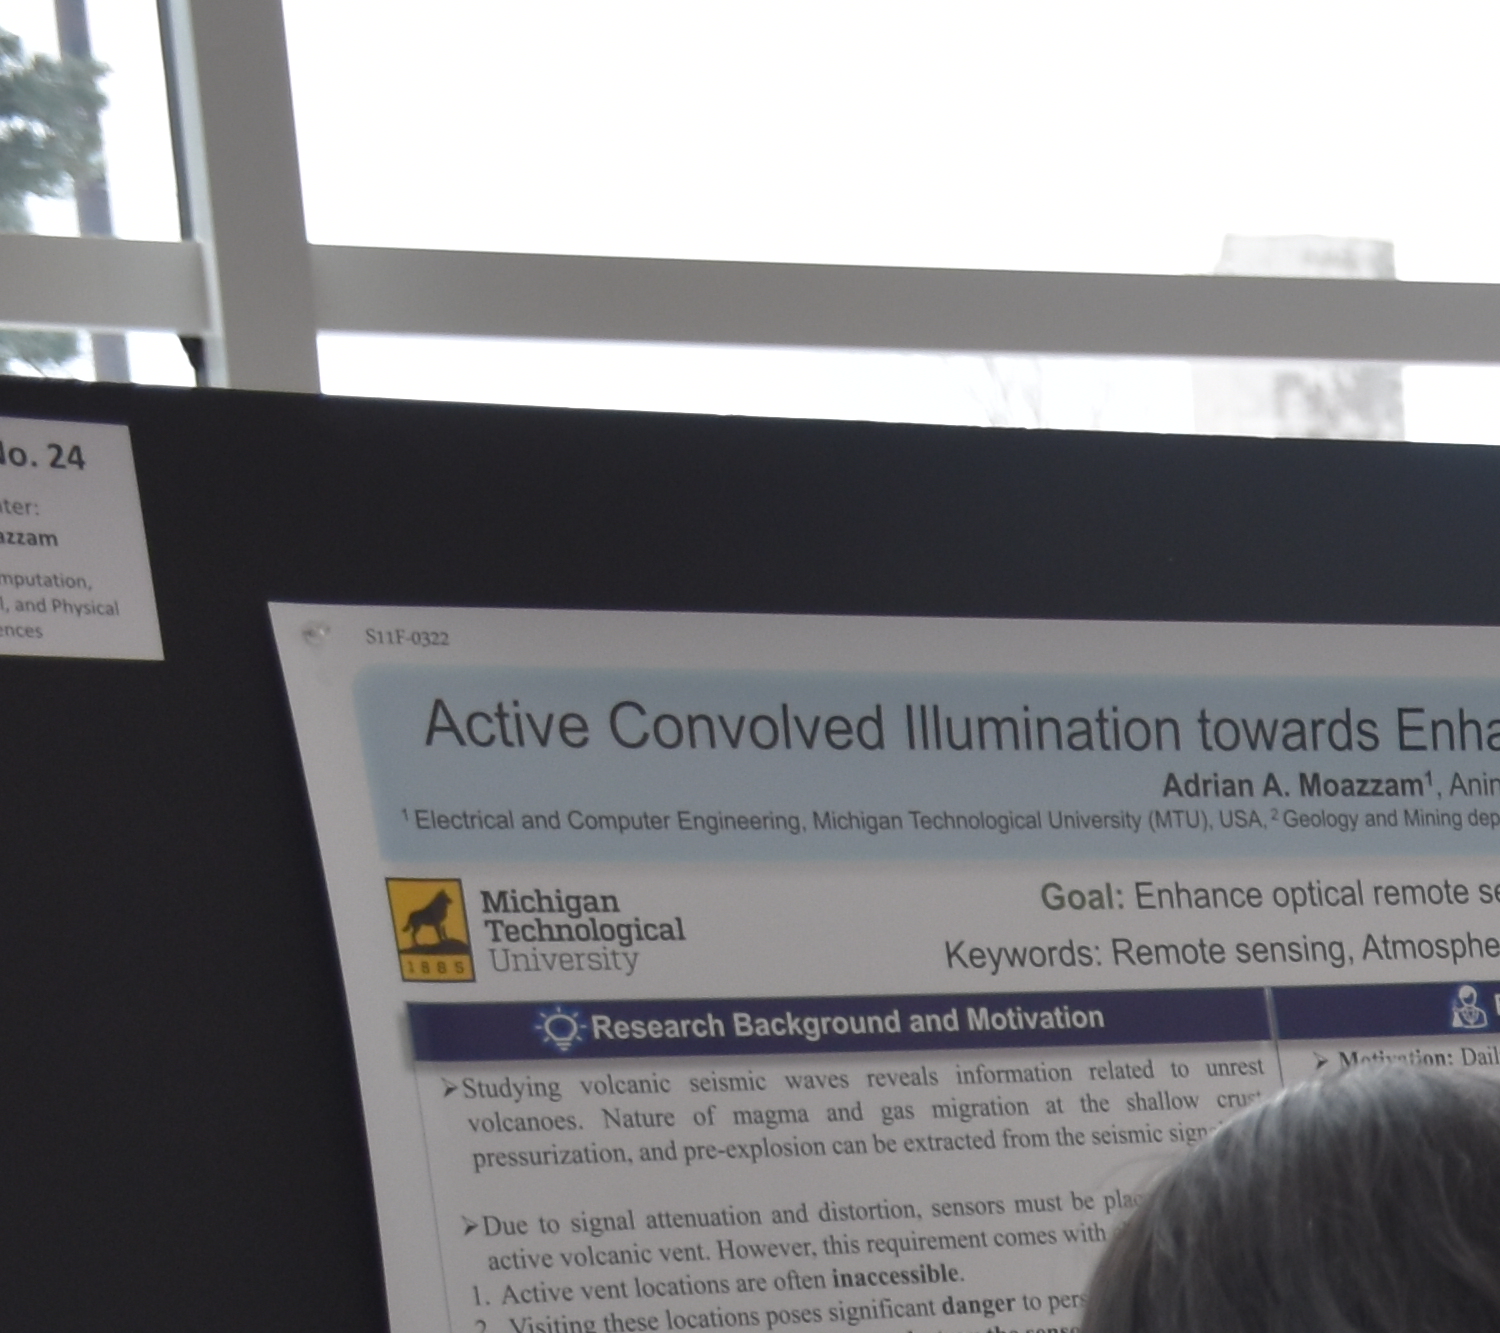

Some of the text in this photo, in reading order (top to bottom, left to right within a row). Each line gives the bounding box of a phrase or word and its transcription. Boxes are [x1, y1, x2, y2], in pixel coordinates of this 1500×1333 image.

[47, 442, 86, 471] 24
[0, 530, 59, 547] azzam
[0, 572, 93, 592] mputation,
[15, 598, 120, 617] and Physical
[0, 625, 43, 639] ences
[365, 628, 449, 647] S11F-0322
[425, 698, 589, 749] Active
[609, 700, 885, 751] Convolved
[906, 704, 1180, 751] Illumination
[1197, 707, 1380, 752] towards
[1163, 772, 1254, 798] Adrian
[1262, 772, 1290, 797] A.
[480, 888, 620, 919] Michigan
[1041, 882, 1124, 910] Goal:
[1135, 881, 1262, 909] Enhance
[1272, 879, 1364, 914] optical
[1373, 879, 1469, 906] remote
[484, 914, 686, 947] Technological
[408, 960, 465, 976] 1885
[488, 948, 640, 976] University
[945, 939, 1101, 976] Keywords:
[1111, 938, 1226, 966] Remote
[1236, 935, 1353, 968] sensing,
[592, 1005, 1104, 1041] Research Background and Motivation
[462, 1059, 1265, 1103] Studying volcanic seismic waves reveals information related to unrest
